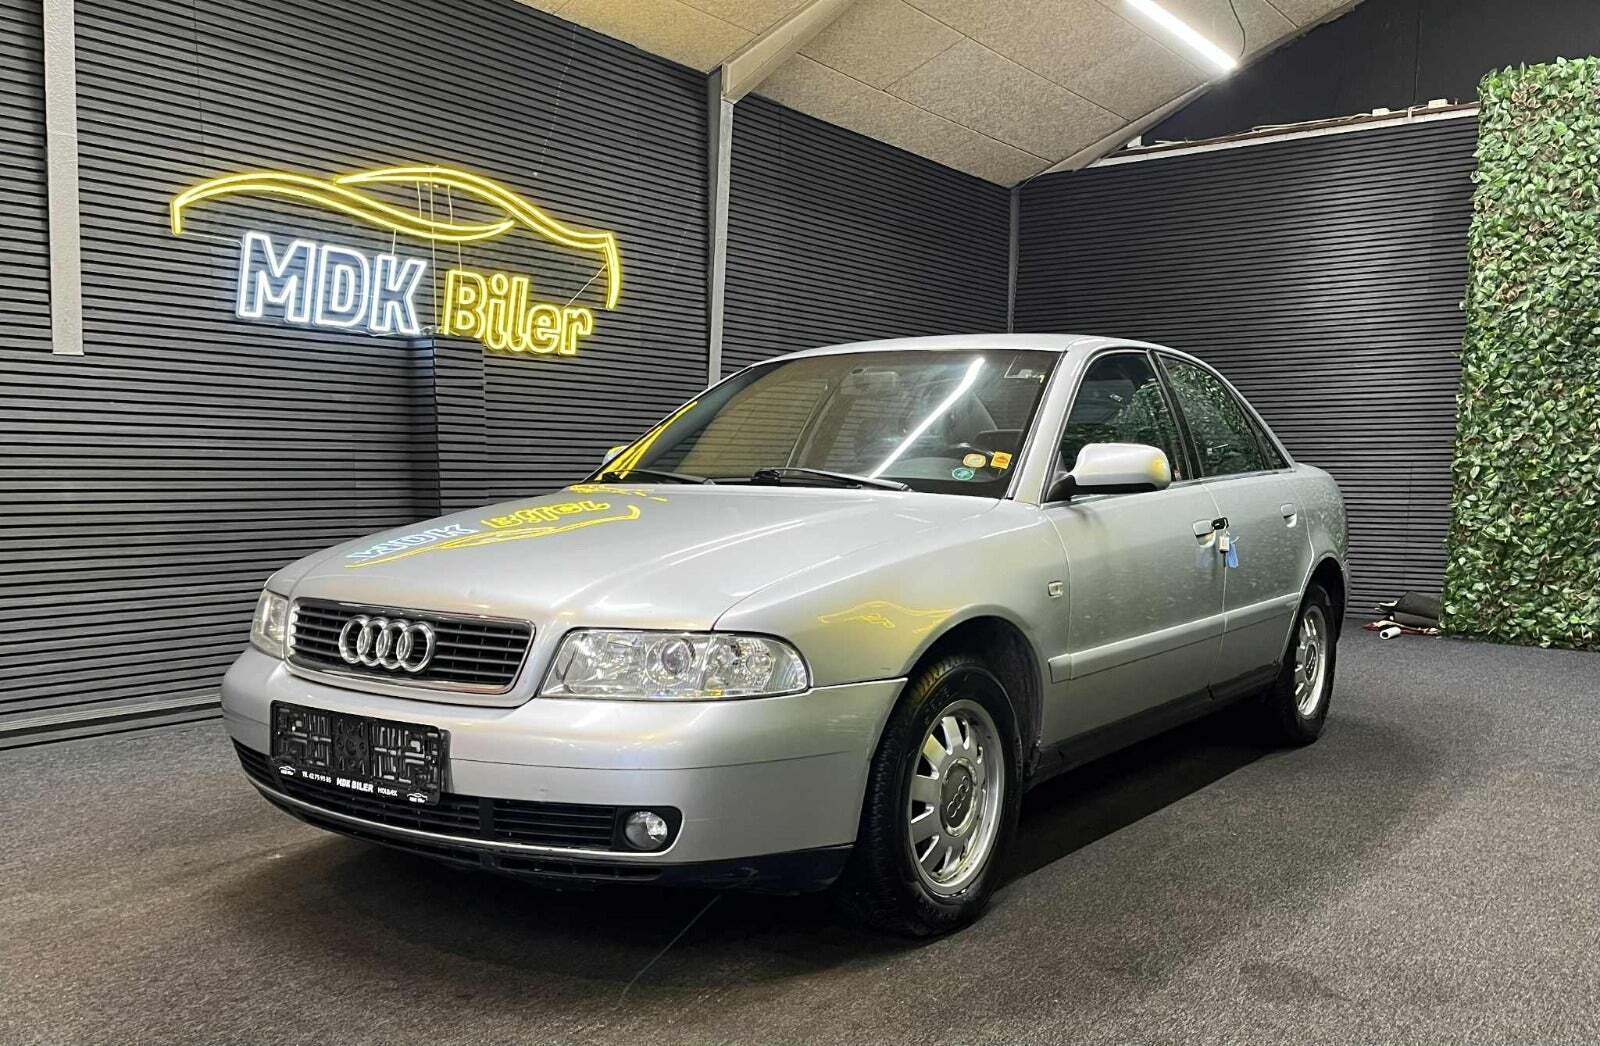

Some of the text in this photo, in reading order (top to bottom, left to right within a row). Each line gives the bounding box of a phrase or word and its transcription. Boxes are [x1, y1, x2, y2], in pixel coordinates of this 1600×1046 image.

[235, 231, 594, 357] MDK Biler
[351, 780, 374, 793] BILER
